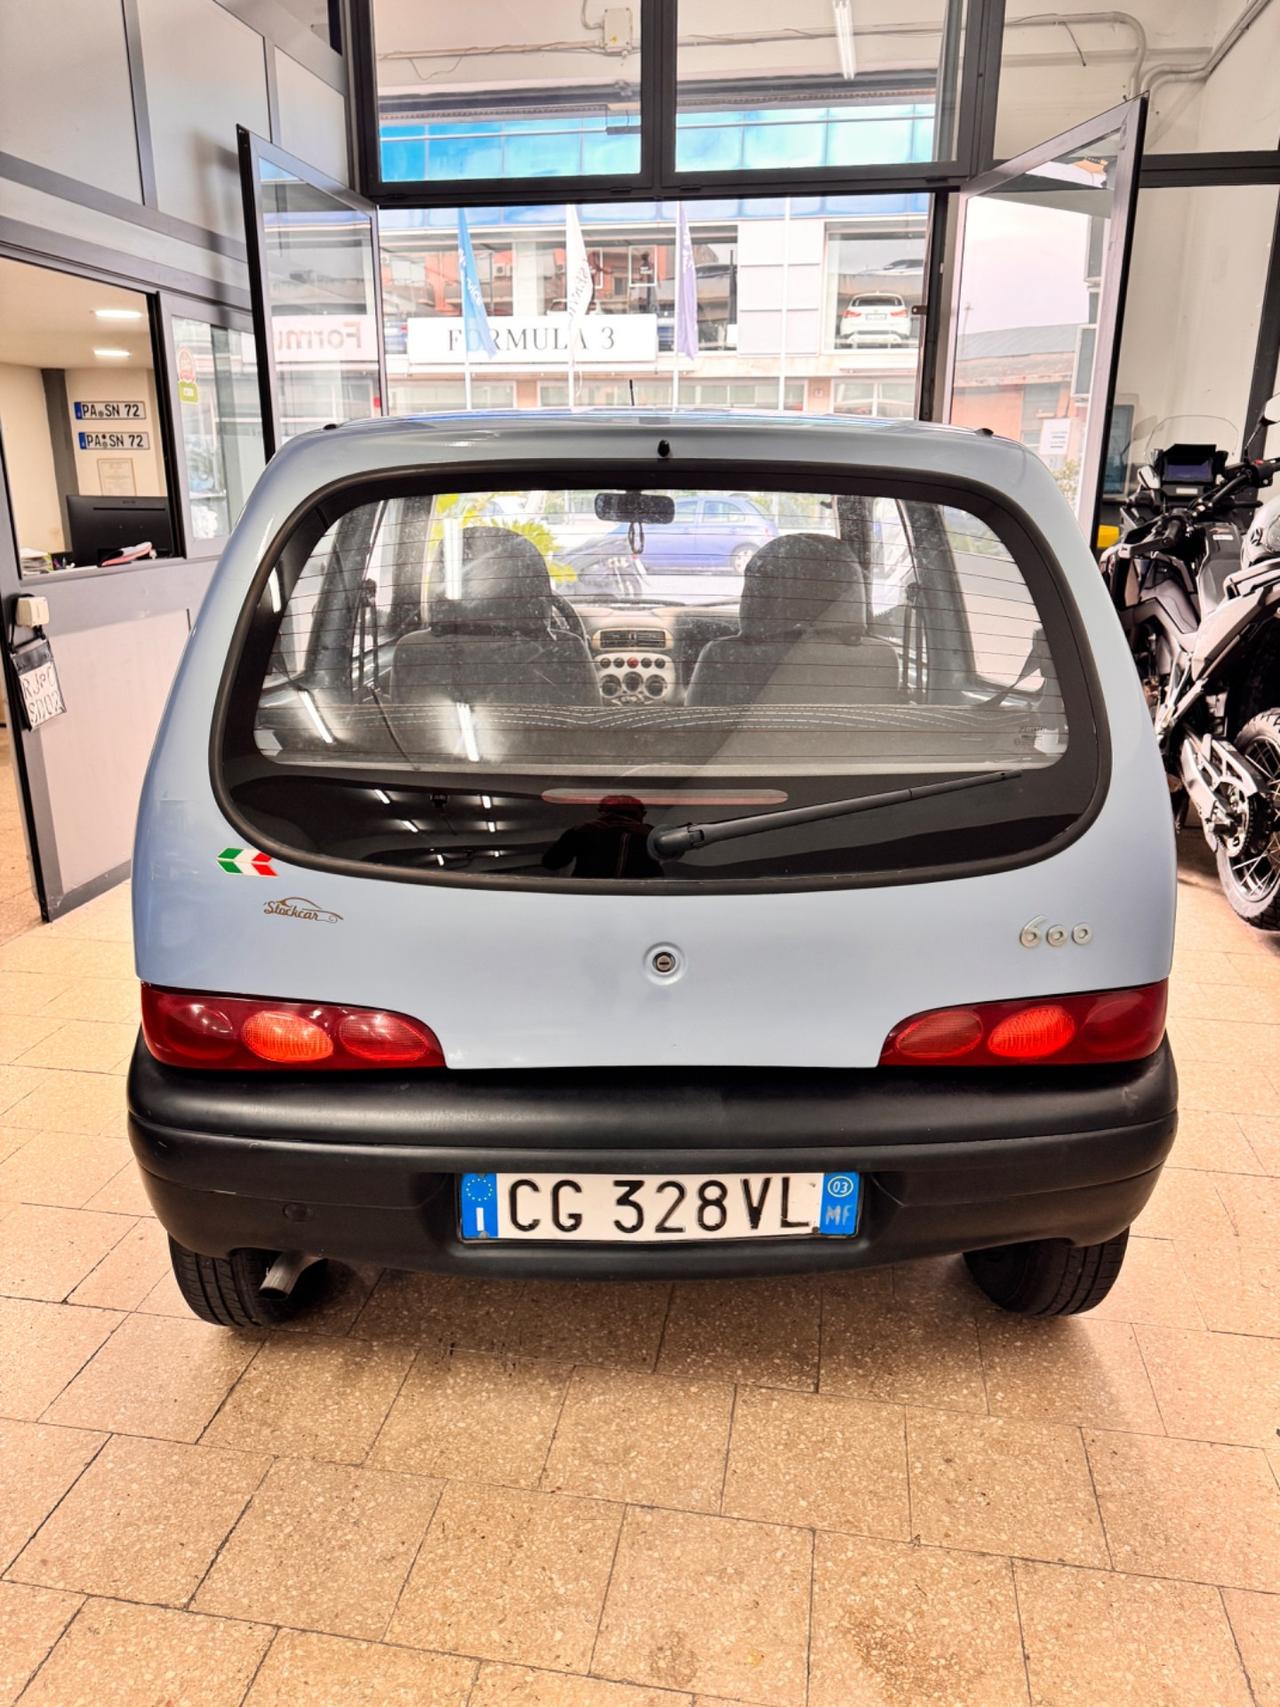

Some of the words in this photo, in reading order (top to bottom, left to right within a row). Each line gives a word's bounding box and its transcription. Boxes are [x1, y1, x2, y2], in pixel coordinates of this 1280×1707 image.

[601, 327, 615, 350] 3
[82, 404, 97, 417] PA
[104, 404, 121, 417] SN
[124, 404, 140, 417] 72
[87, 434, 101, 448] PA
[109, 434, 125, 448] SN
[129, 434, 144, 448] 72
[263, 899, 319, 921] Stockcar
[1019, 914, 1091, 949] 600
[833, 1181, 849, 1194] 03
[509, 1179, 583, 1232] CG
[826, 1205, 853, 1226] MF
